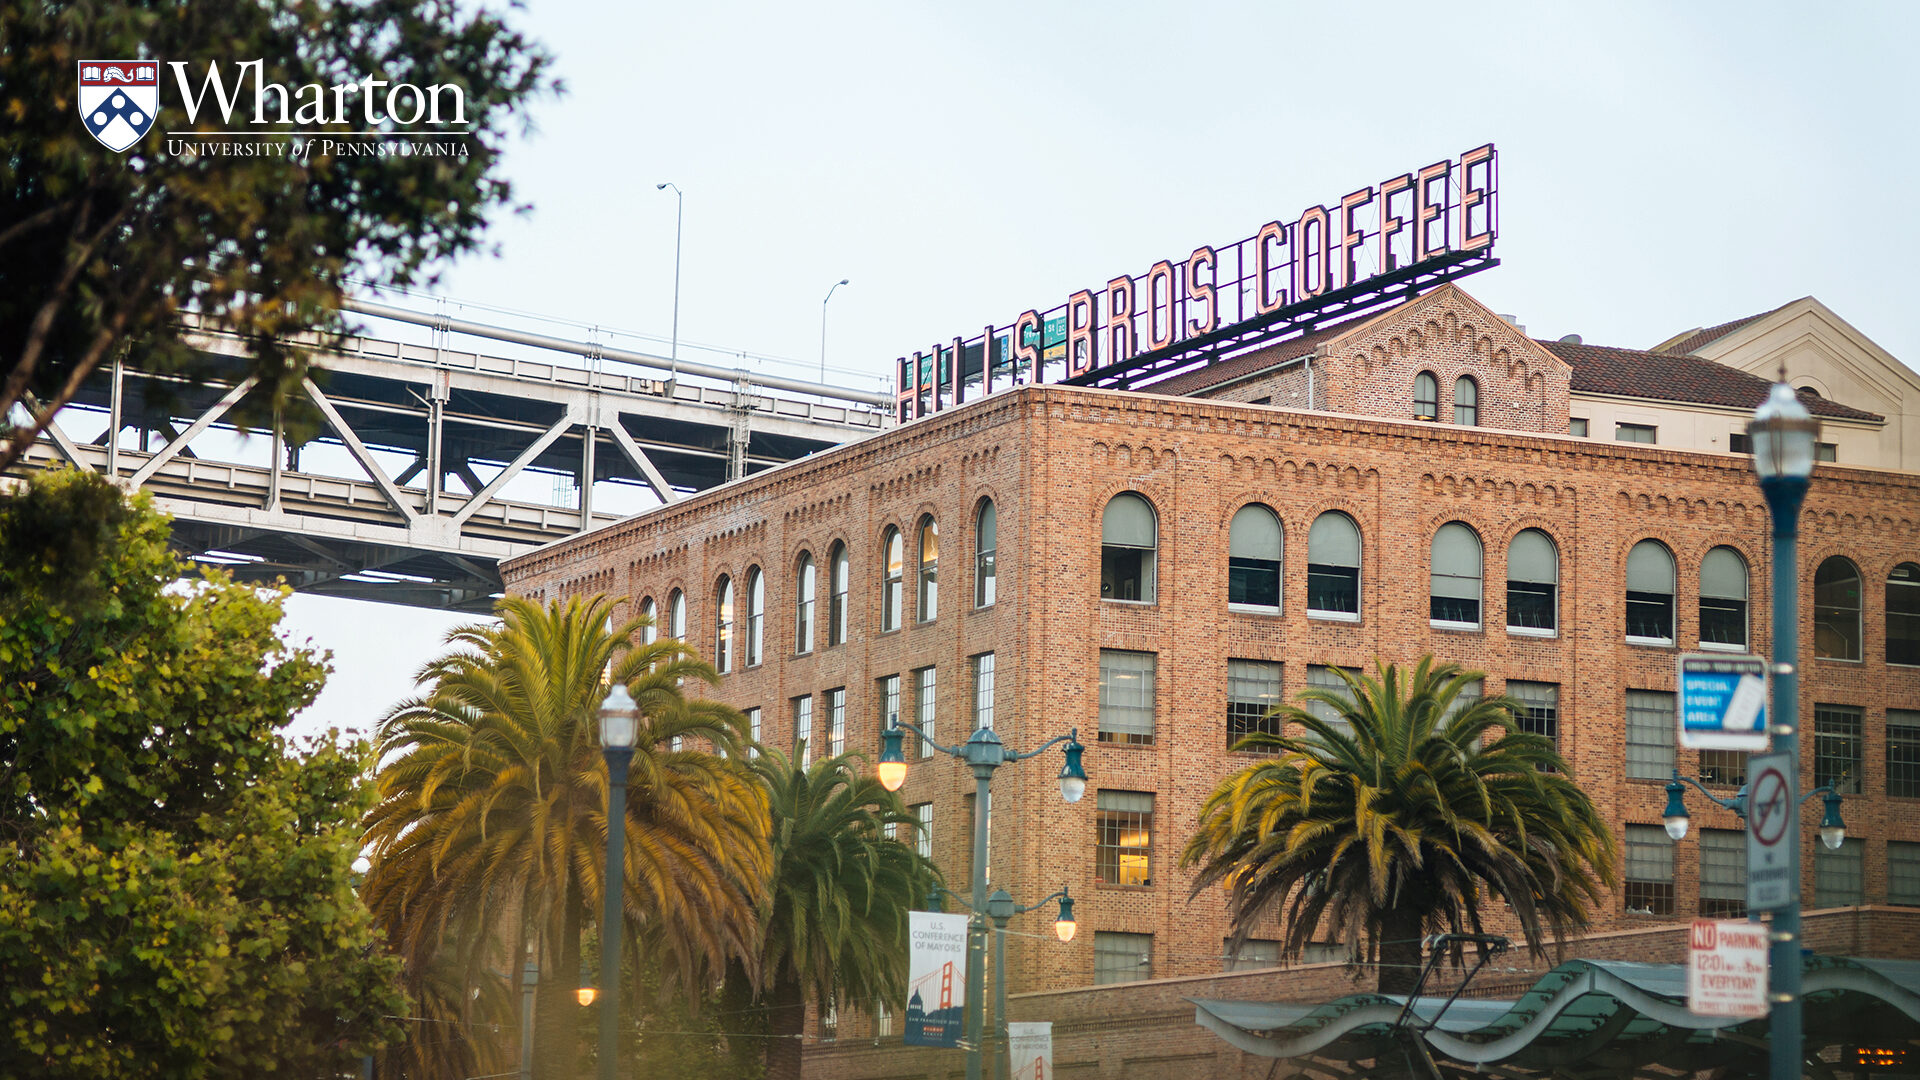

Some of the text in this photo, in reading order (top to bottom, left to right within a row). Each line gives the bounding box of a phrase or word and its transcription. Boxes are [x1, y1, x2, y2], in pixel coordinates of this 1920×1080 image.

[1069, 245, 1219, 379] BROS
[1255, 142, 1495, 316] COFFEE
[930, 922, 946, 930] U.S.
[912, 931, 965, 943] CONFERENCE
[1694, 923, 1766, 950] NO PARKING
[915, 941, 961, 952] OF MAYORS
[1701, 973, 1757, 990] EVERYDAY
